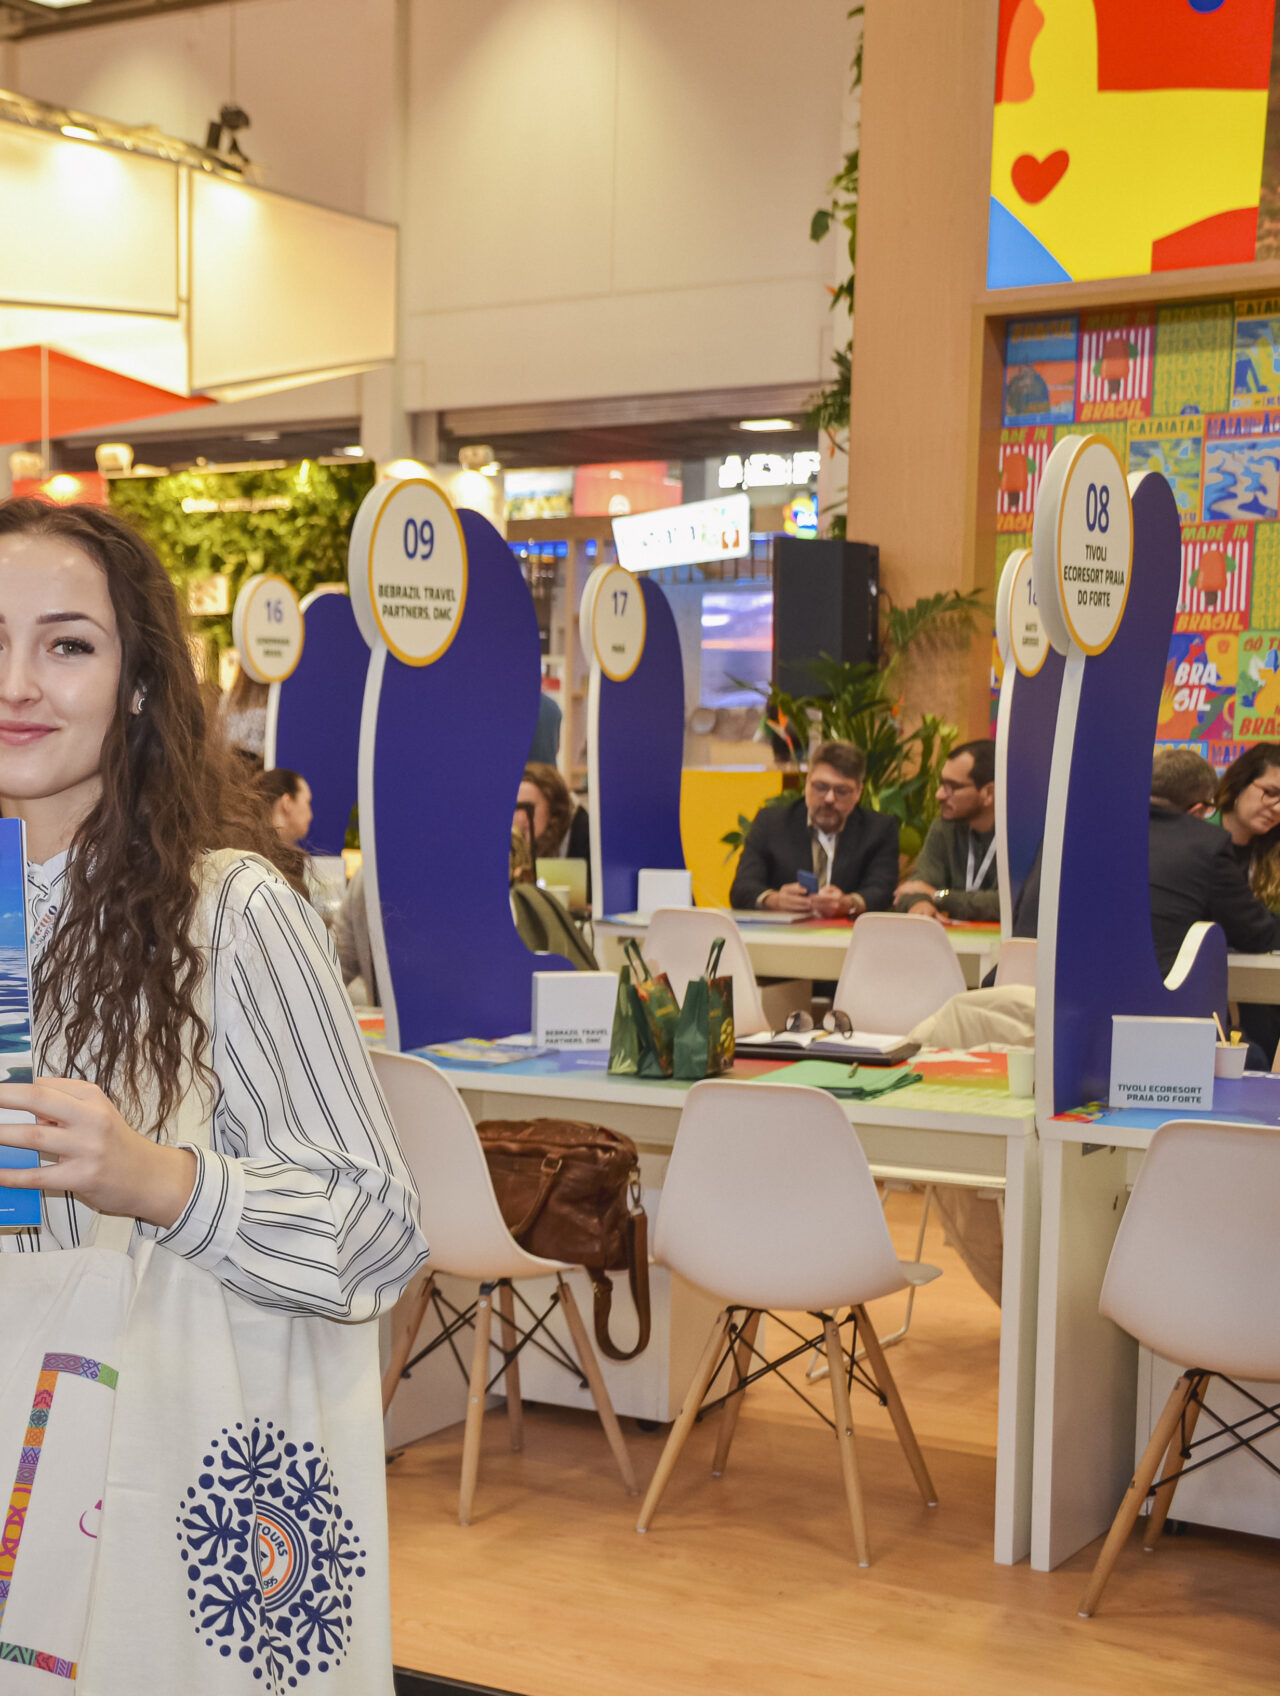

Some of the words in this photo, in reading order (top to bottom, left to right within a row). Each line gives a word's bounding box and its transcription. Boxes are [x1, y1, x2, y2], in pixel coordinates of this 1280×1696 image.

[1080, 401, 1146, 422] BRASIL
[1086, 483, 1109, 533] 08
[404, 518, 435, 560] 09
[1182, 526, 1227, 540] MADE
[1233, 525, 1248, 539] IN
[1085, 544, 1107, 562] TIVOLI
[1064, 565, 1104, 585] ECORESORT
[1105, 570, 1125, 586] PRAIA
[378, 584, 421, 600] BEBRAZIL
[424, 587, 456, 602] TRAVEL
[1077, 590, 1088, 606] DO
[1089, 591, 1111, 607] FORTE
[266, 599, 283, 624] 16
[433, 606, 452, 621] DMC
[613, 591, 628, 616] 17
[1176, 612, 1244, 632] BRASIL
[1174, 662, 1217, 686] BRA
[1174, 688, 1211, 712] SIL
[1118, 1083, 1147, 1093] TIVOLI
[1148, 1084, 1202, 1094] ECORESORT
[1126, 1094, 1154, 1102] PRAIA
[1156, 1094, 1170, 1103] DO
[1171, 1095, 1202, 1104] FORTE
